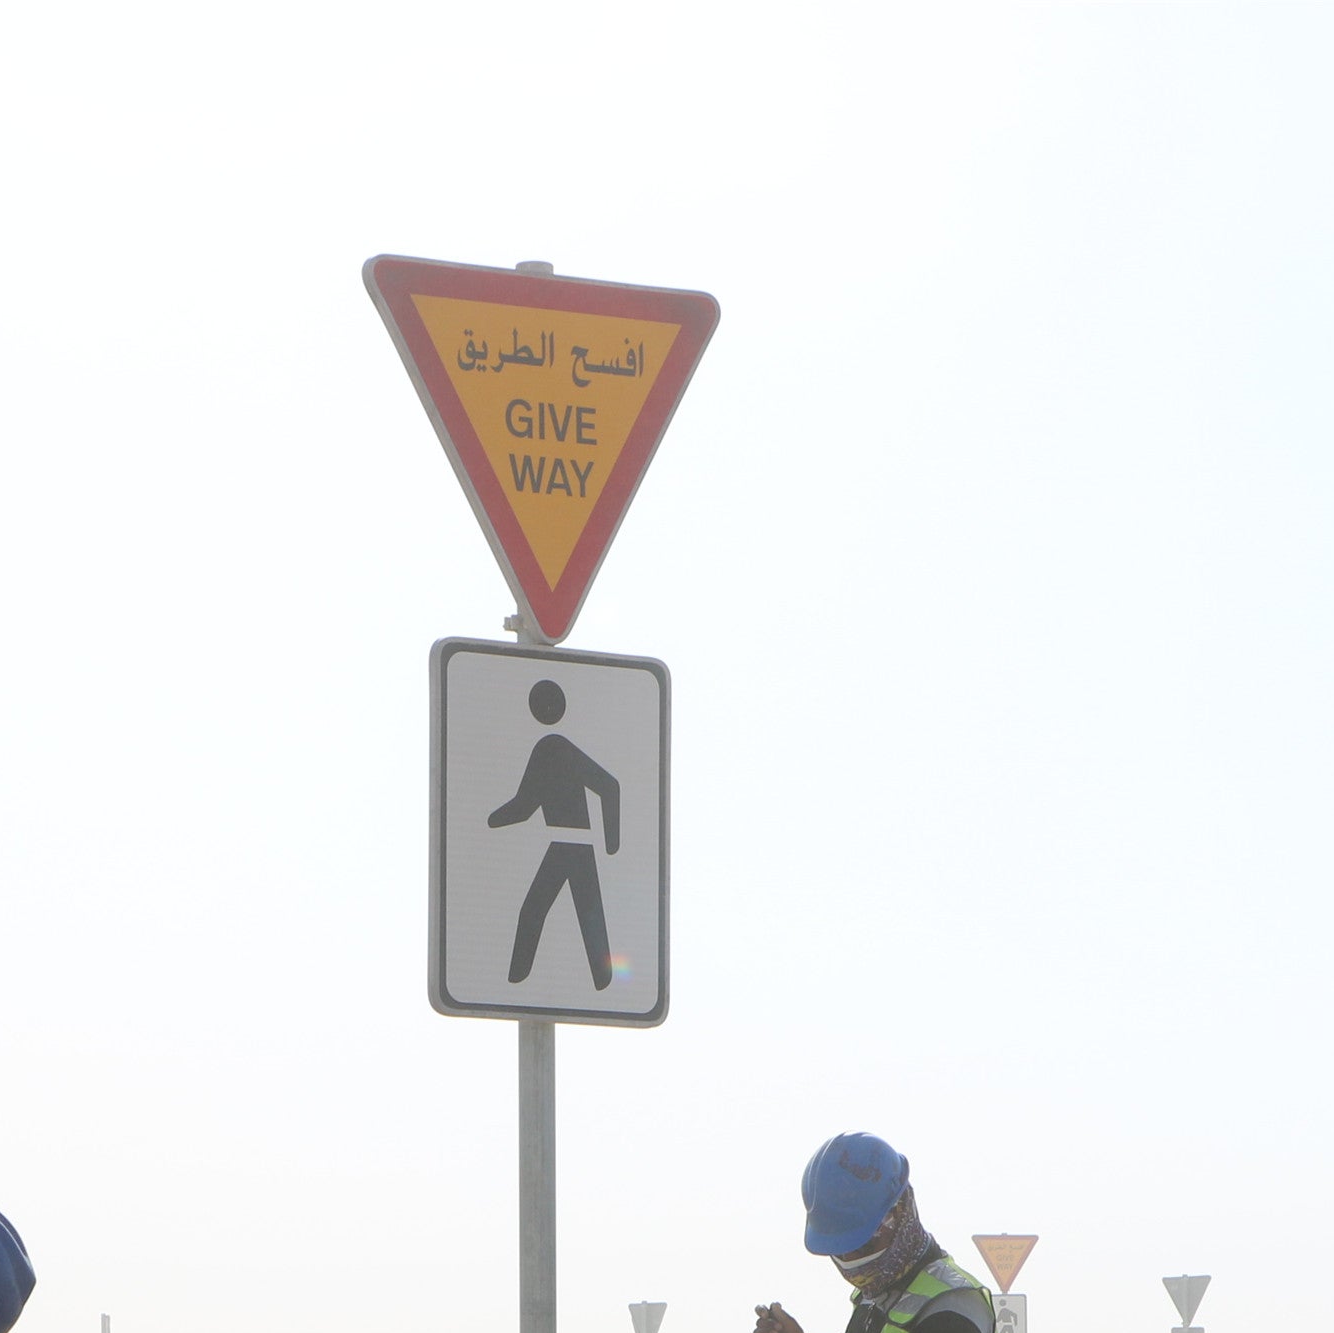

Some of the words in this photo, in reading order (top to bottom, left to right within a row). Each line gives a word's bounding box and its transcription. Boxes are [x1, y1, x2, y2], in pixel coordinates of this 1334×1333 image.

[457, 328, 555, 373] الطريق
[571, 337, 644, 387] افسح
[504, 398, 598, 446] GIVE
[508, 453, 595, 498] WAY
